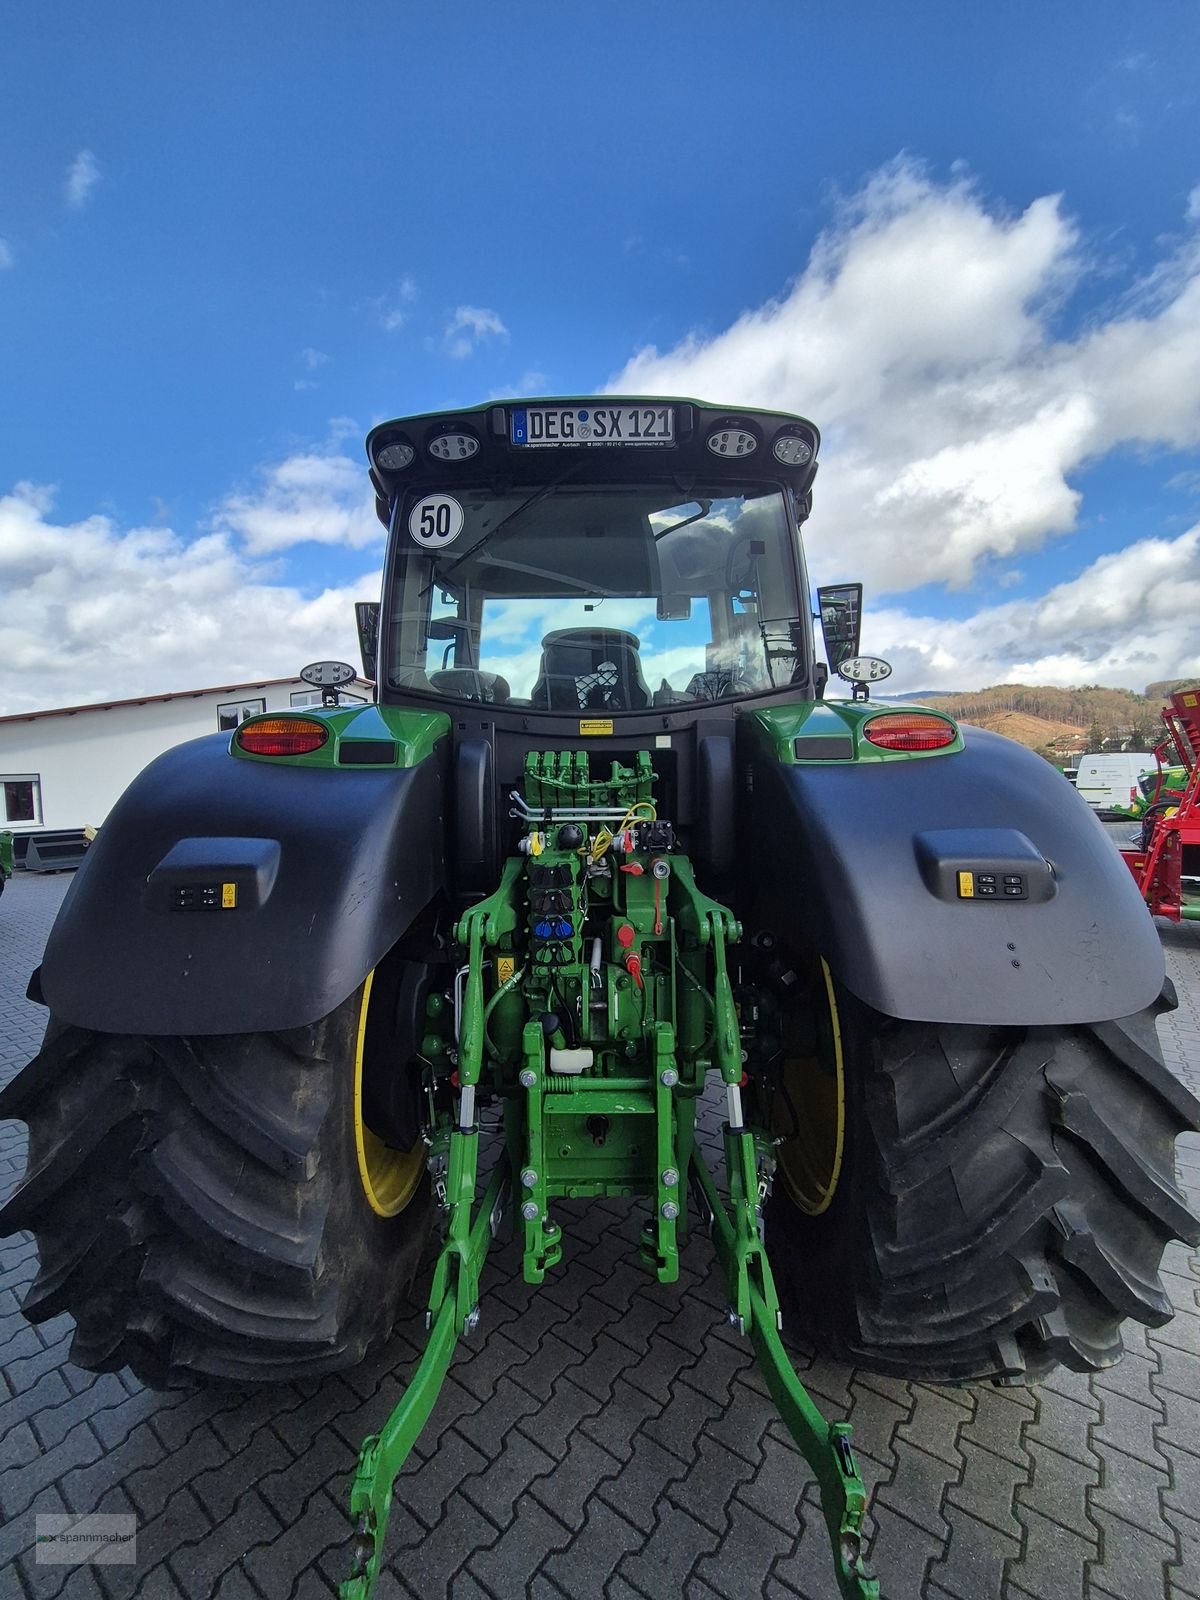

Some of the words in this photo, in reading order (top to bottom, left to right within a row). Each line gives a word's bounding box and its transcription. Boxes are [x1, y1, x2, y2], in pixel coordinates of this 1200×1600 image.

[529, 411, 574, 439] DEG
[593, 410, 622, 438] SX
[628, 409, 671, 437] 121
[420, 504, 451, 538] 50
